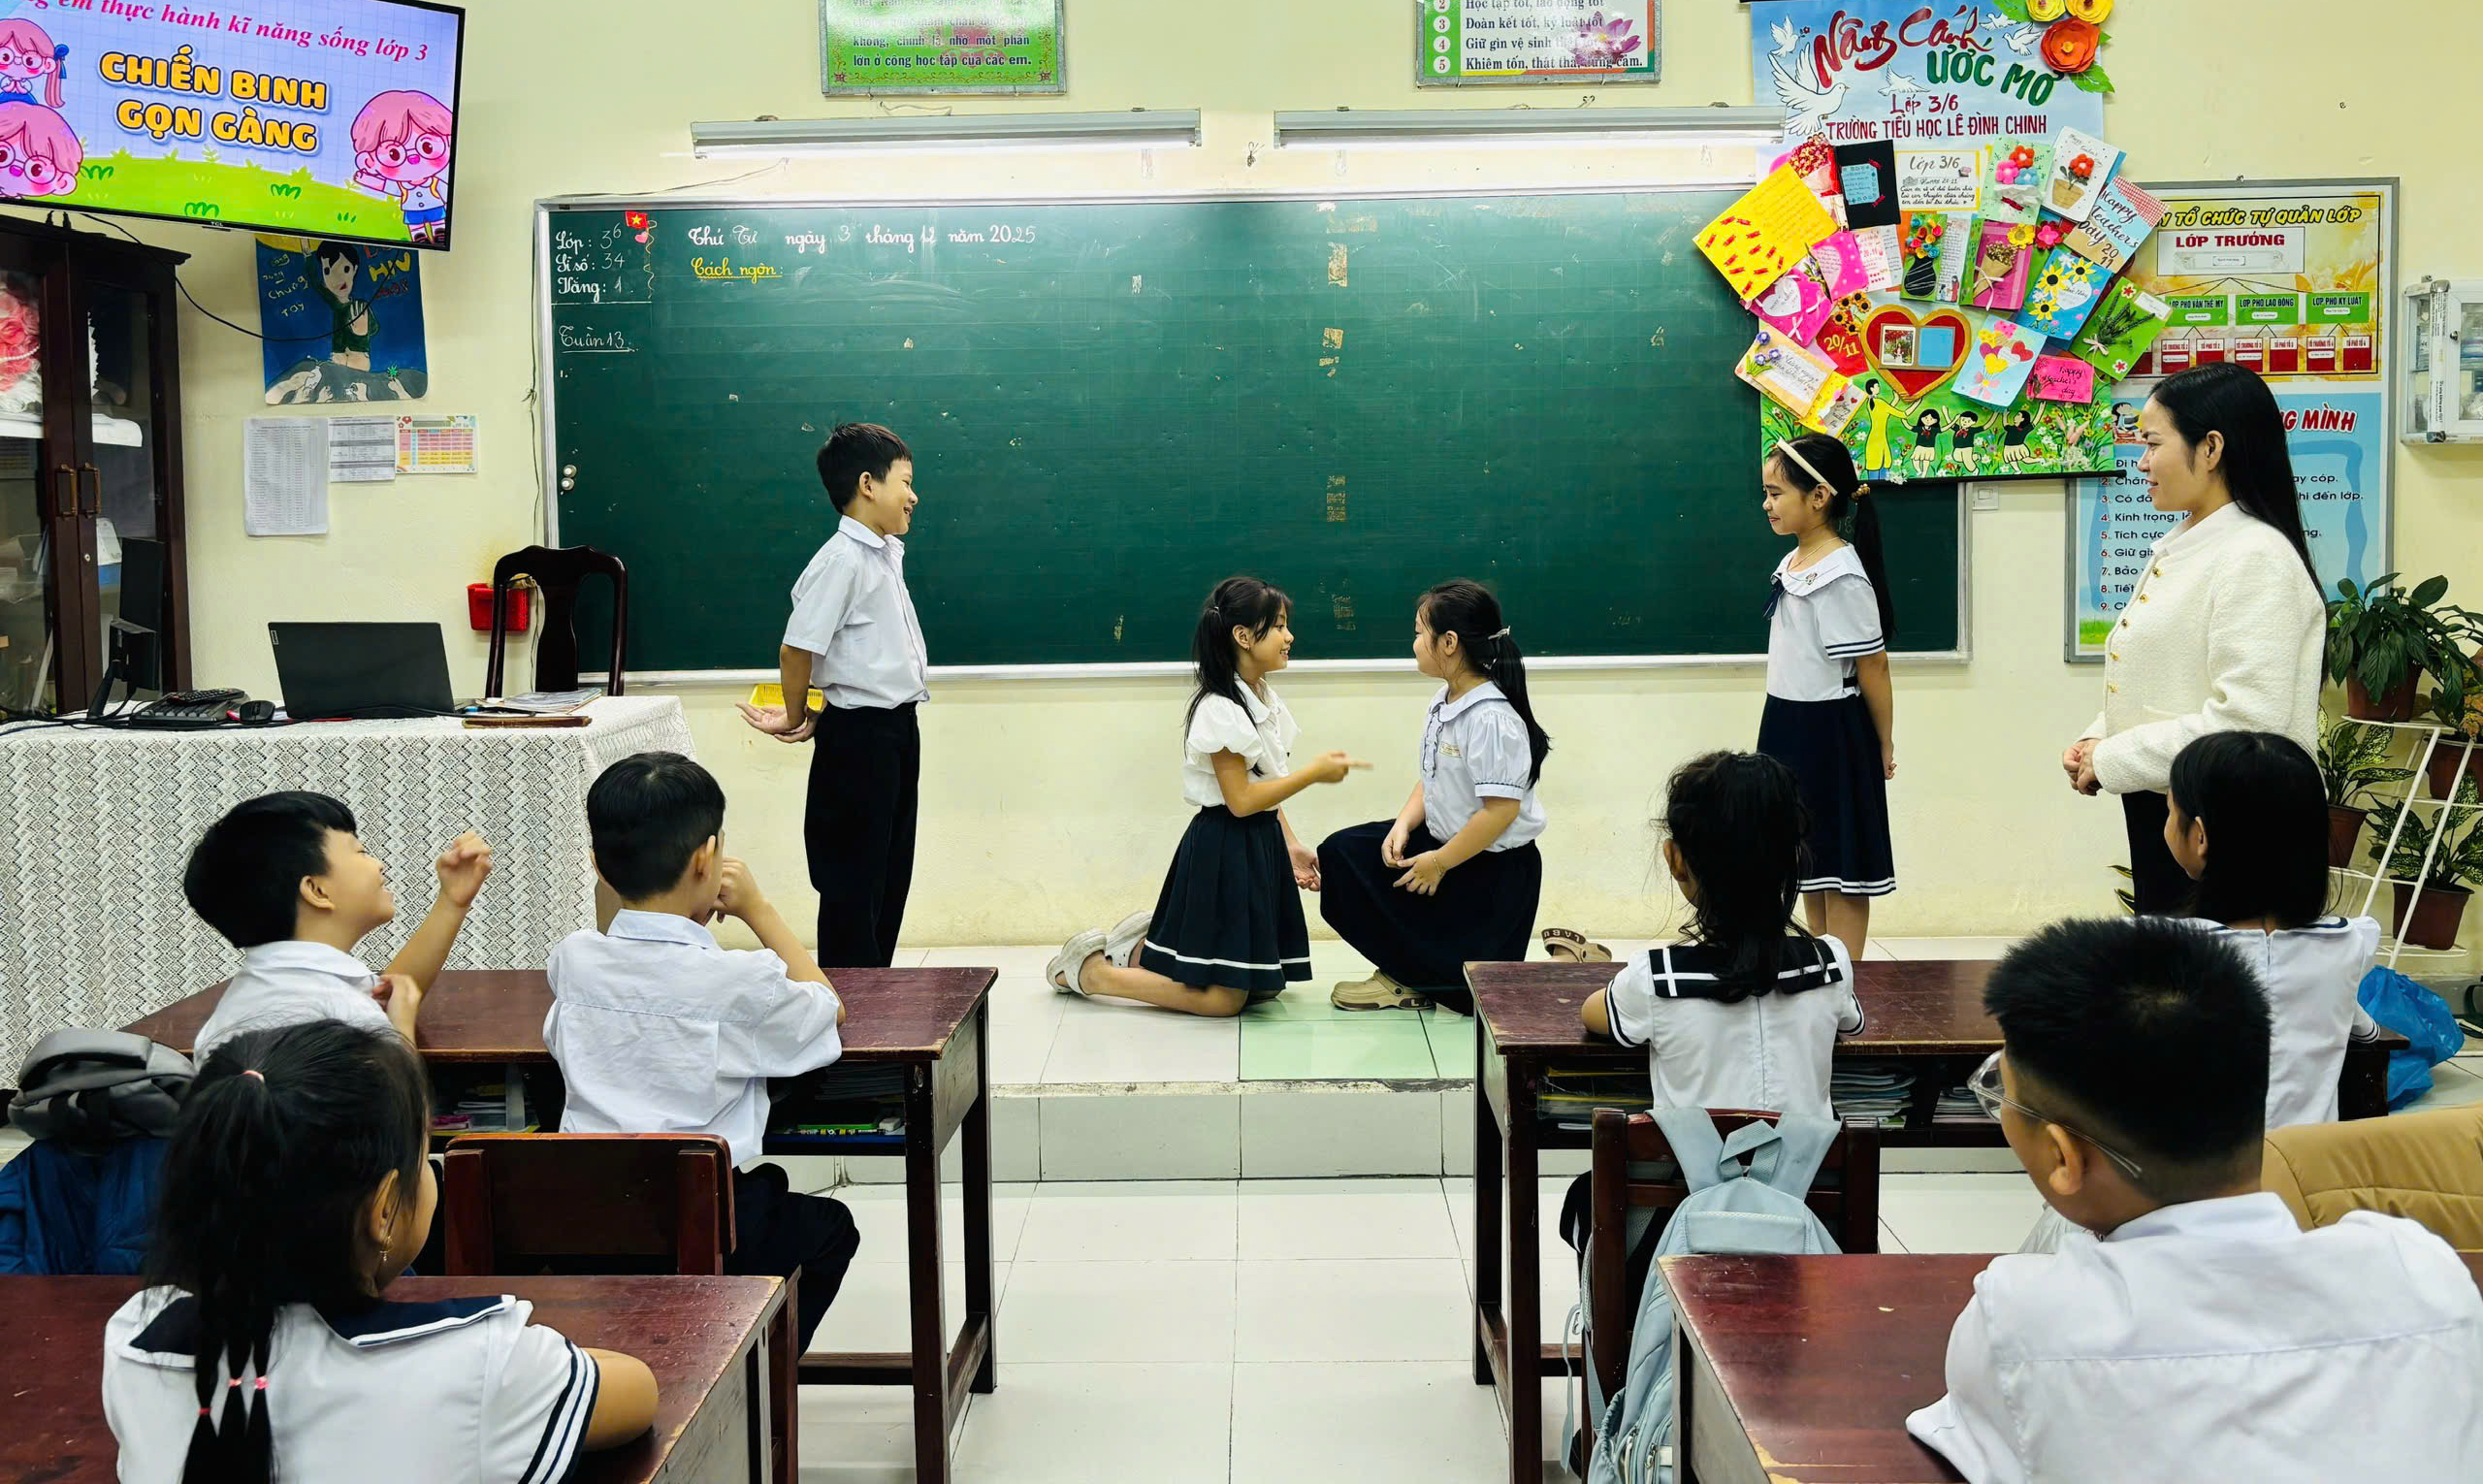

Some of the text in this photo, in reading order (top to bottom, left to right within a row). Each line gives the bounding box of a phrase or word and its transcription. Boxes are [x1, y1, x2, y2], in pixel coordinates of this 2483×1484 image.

[101, 0, 154, 21] thực
[161, 4, 220, 29] hành
[228, 14, 252, 33] kĩ
[256, 21, 313, 48] năng
[318, 26, 371, 56] sống
[375, 37, 409, 62] lớp
[414, 44, 429, 60] 3
[1439, 18, 1446, 30] 3
[1466, 17, 1496, 29] Đoàn
[1499, 16, 1517, 29] kết
[1438, 36, 1552, 51] 4 Giữ gìn vệ sinh
[1814, 5, 1994, 88] Nâng Cánh
[885, 54, 912, 68] công
[916, 54, 936, 68] học
[940, 54, 957, 67] tập
[962, 53, 982, 65] của
[985, 53, 1005, 65] các
[1009, 56, 1032, 65] em.
[1439, 59, 1445, 71] 5
[1466, 58, 1502, 70] Khiêm
[1506, 55, 1529, 70] tốn,
[99, 44, 328, 110] CHIẾN BINH
[1927, 37, 2066, 107] ƯỚC MƠ
[1889, 94, 1958, 115] Lớp 3/6
[116, 99, 317, 150] GỌN GÀNG
[1825, 112, 2048, 141] TRƯỜNG TIỂU HỌC LÊ ĐÌNH CHINH
[1939, 155, 1961, 169] 3/6
[2100, 191, 2138, 224] Happy
[2175, 207, 2200, 227] TỔ
[2201, 208, 2245, 226] CHỨC
[2250, 207, 2275, 227] TỰ
[2275, 205, 2323, 224] QUẢN
[2327, 206, 2362, 223] LỚP
[688, 225, 725, 246] Thứ
[785, 231, 825, 254] ngày
[837, 225, 852, 242] 3
[865, 224, 915, 253] tháng
[948, 229, 984, 242] năm
[989, 224, 1037, 243] 2025
[2176, 234, 2209, 247] LỚP
[2101, 243, 2119, 259] 20
[600, 252, 626, 270] 34
[691, 257, 732, 276] Cách
[2100, 256, 2114, 270] 11
[2265, 298, 2276, 307] LAO
[2301, 403, 2357, 433] MÌNH
[2293, 475, 2307, 484] ay
[2310, 473, 2338, 484] cóp.
[2114, 493, 2133, 503] Có
[2312, 490, 2337, 500] đến
[2340, 492, 2364, 501] lớp.
[2114, 512, 2140, 522] Kính
[2143, 512, 2178, 523] trọng,
[2114, 530, 2138, 539] Tích
[2142, 531, 2165, 539] cực
[2114, 548, 2136, 557] Giữ
[2114, 566, 2139, 575] Bảo
[2100, 585, 2112, 594] 8.
